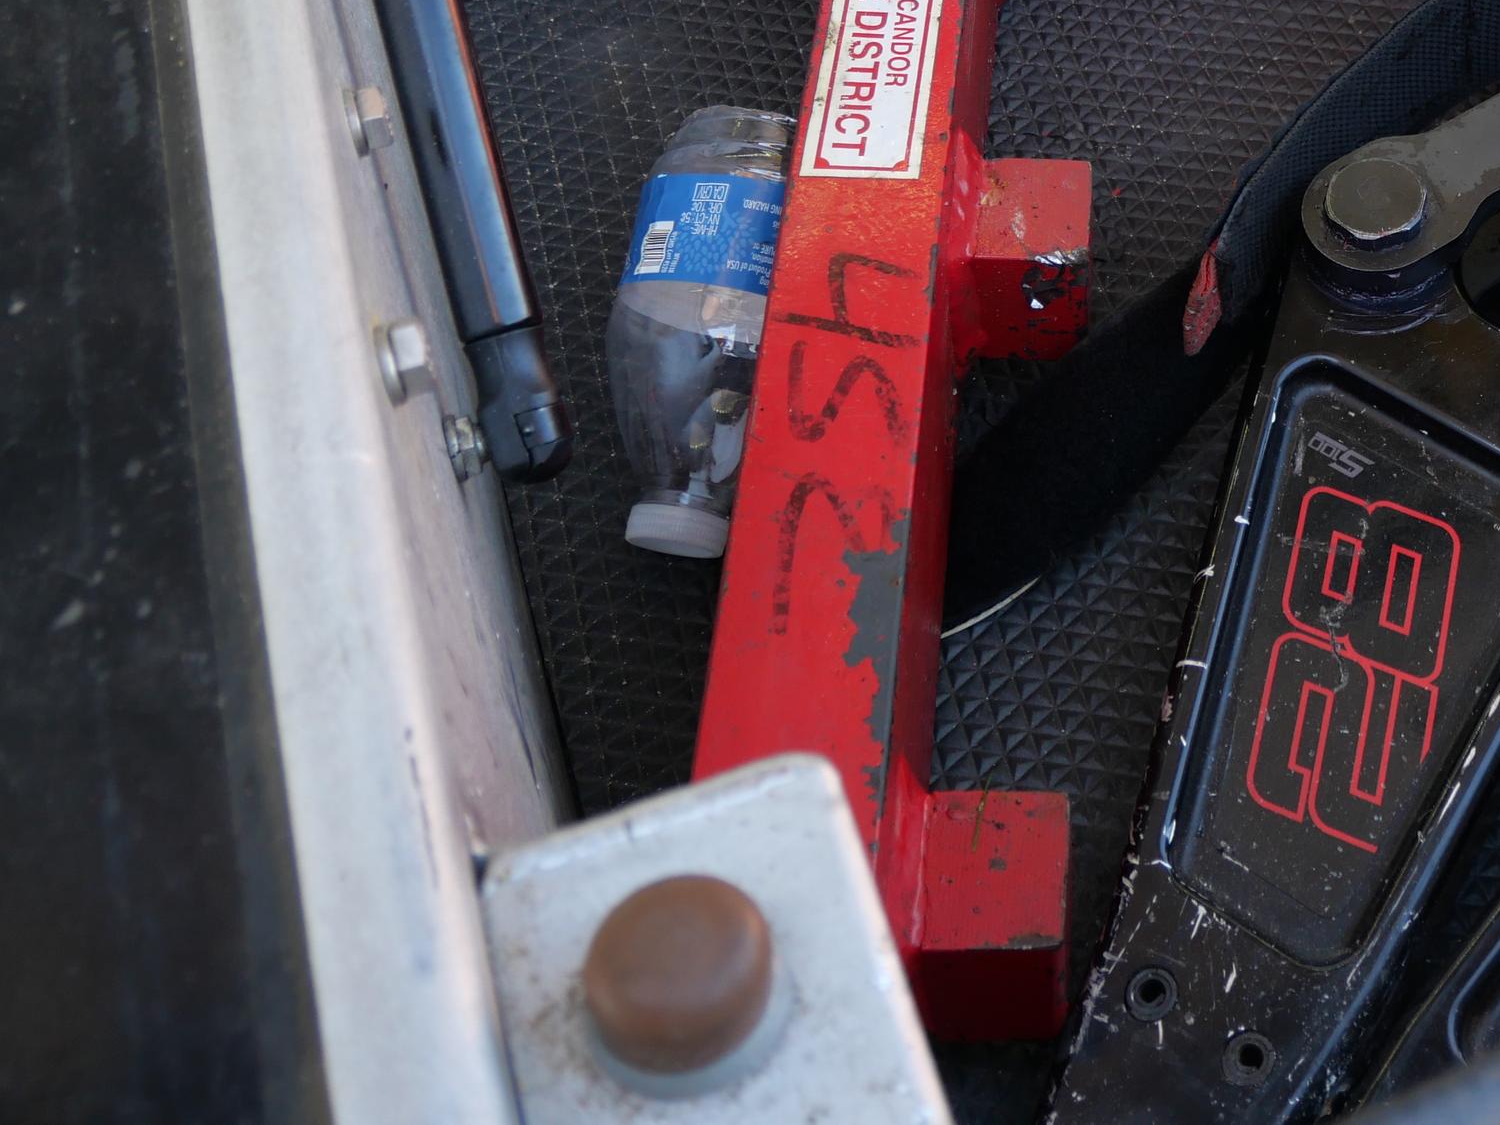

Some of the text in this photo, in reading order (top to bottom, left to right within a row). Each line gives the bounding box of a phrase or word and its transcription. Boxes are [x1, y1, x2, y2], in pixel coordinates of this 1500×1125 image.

[831, 10, 888, 157] DISTRICT
[713, 185, 725, 199] CA
[1308, 431, 1376, 478] S100
[1247, 485, 1461, 853] 28
